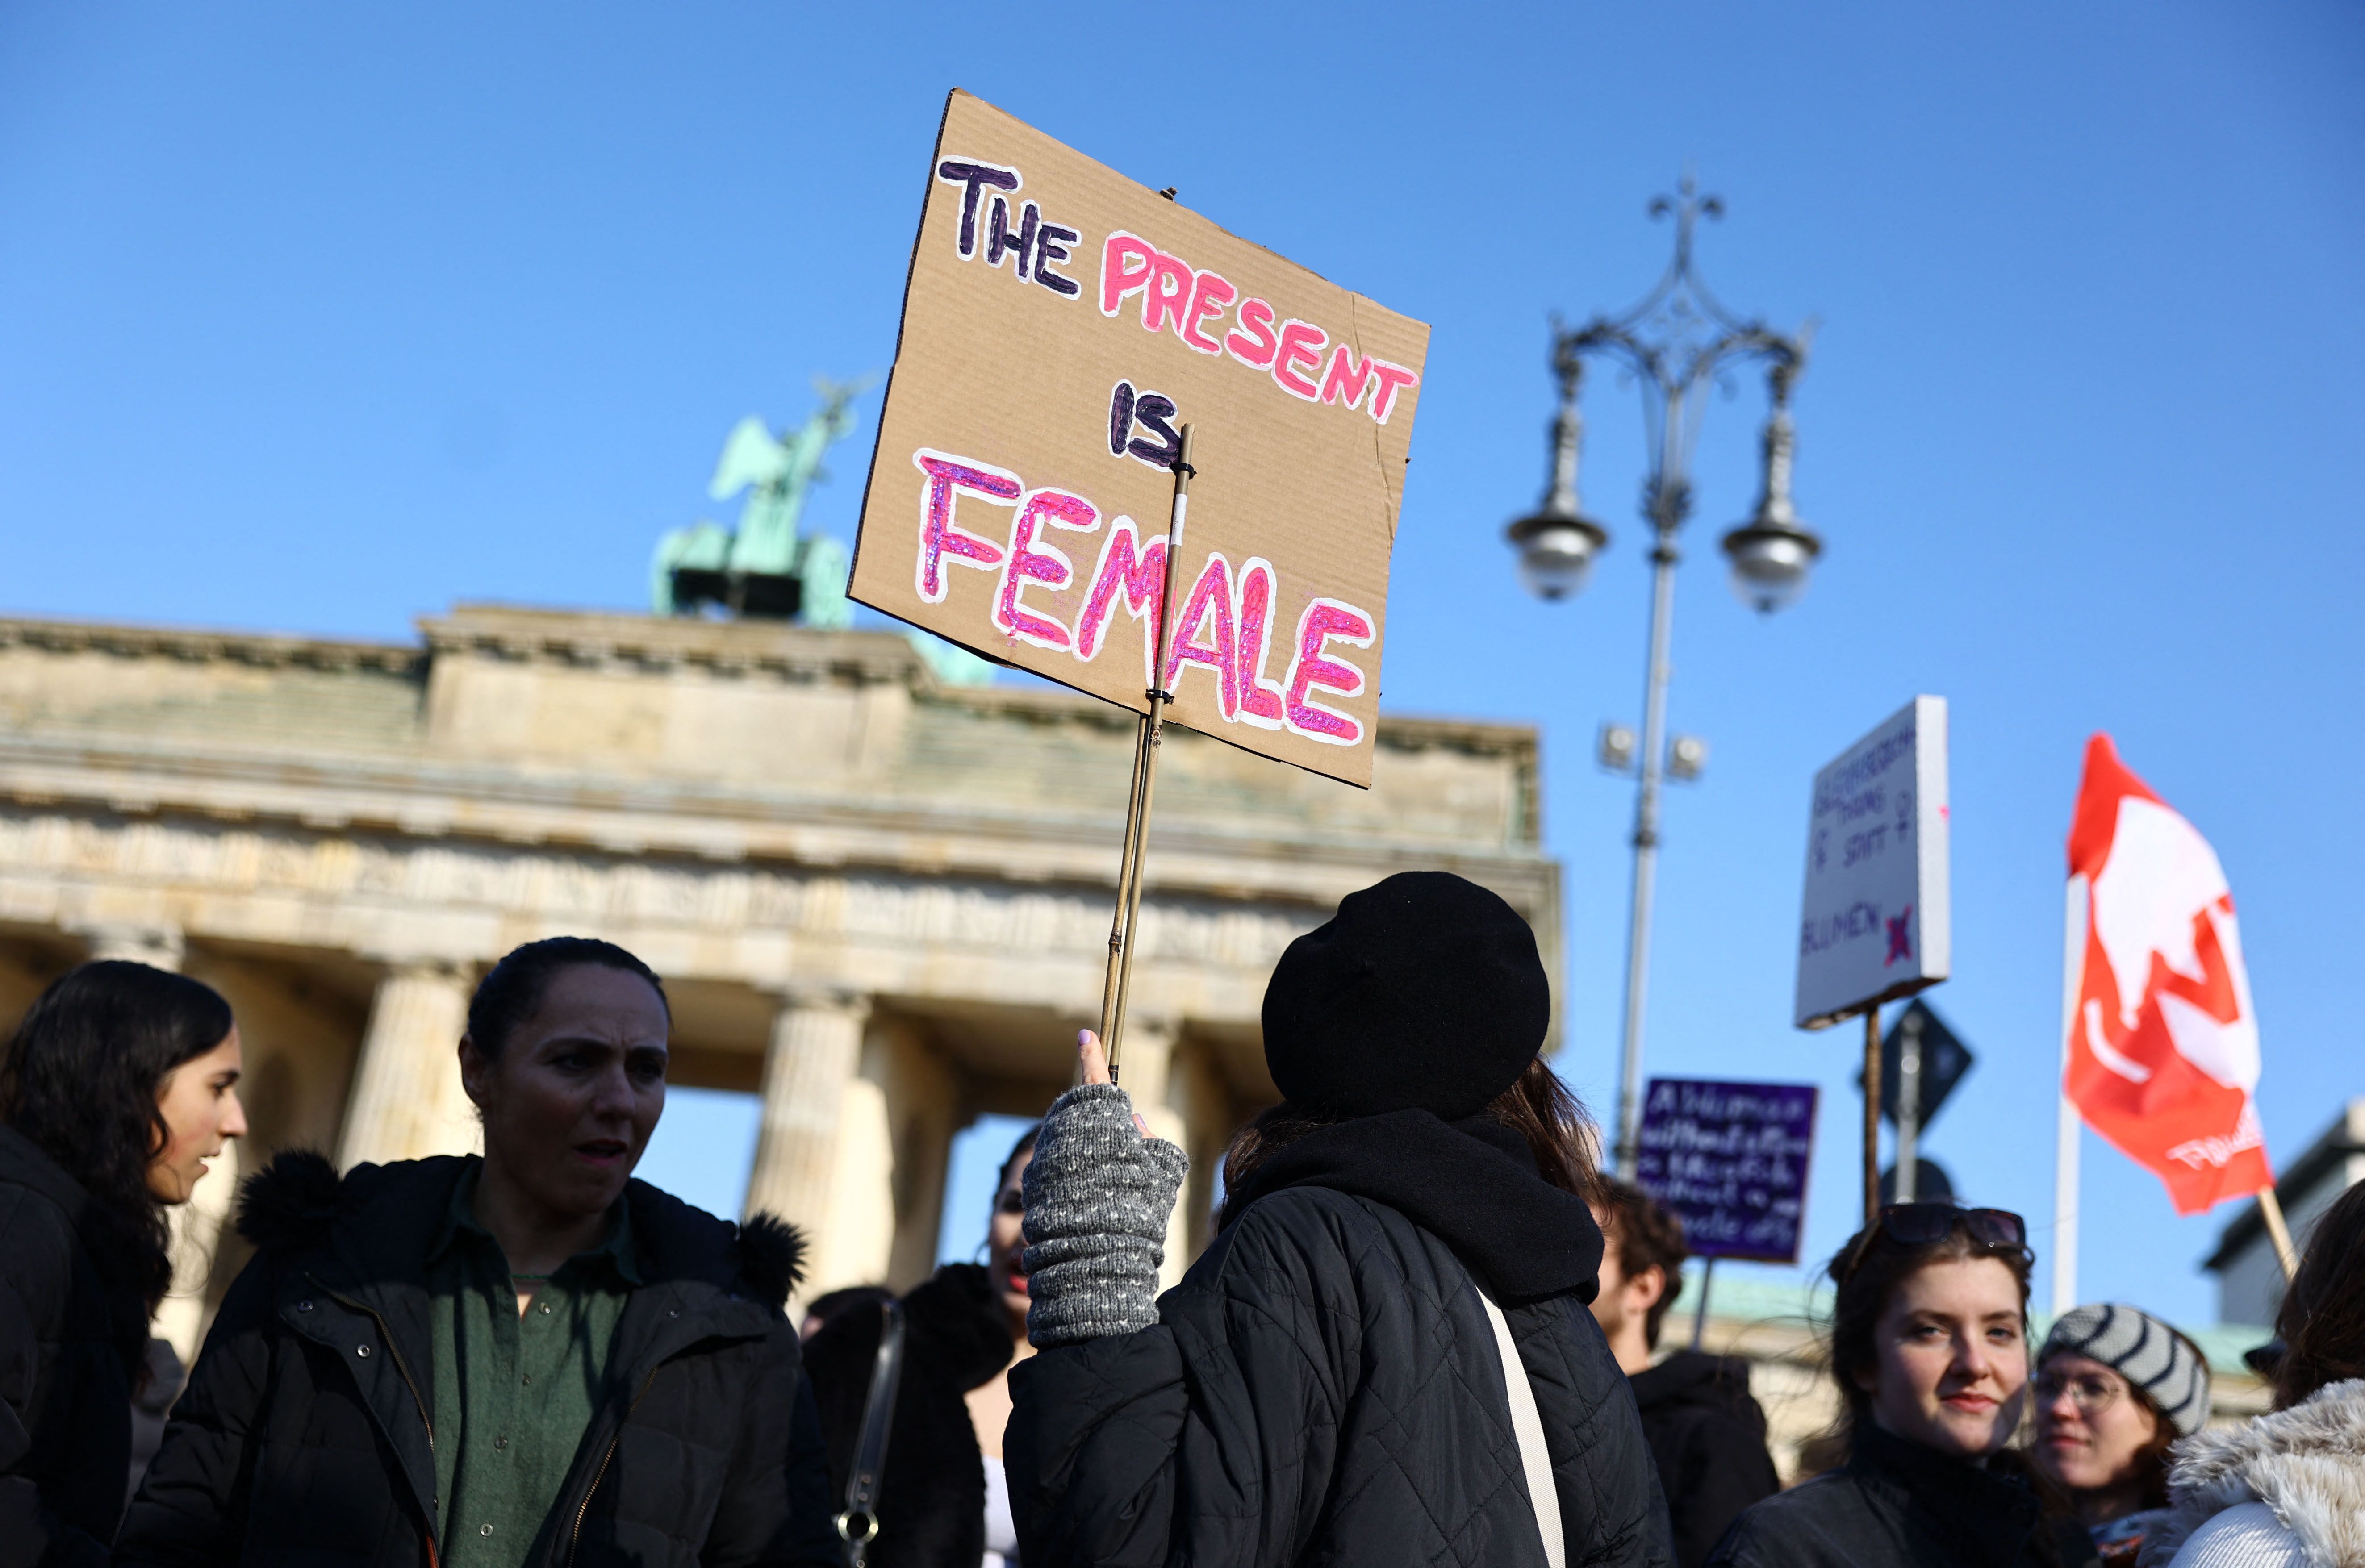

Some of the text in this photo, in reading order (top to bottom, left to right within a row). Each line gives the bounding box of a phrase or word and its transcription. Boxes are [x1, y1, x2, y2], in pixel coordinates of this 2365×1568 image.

[939, 154, 1419, 425] THE PRESENT
[1108, 378, 1182, 471] IS
[913, 448, 1376, 746] FEMALE
[1801, 901, 1882, 958] BLUMEN
